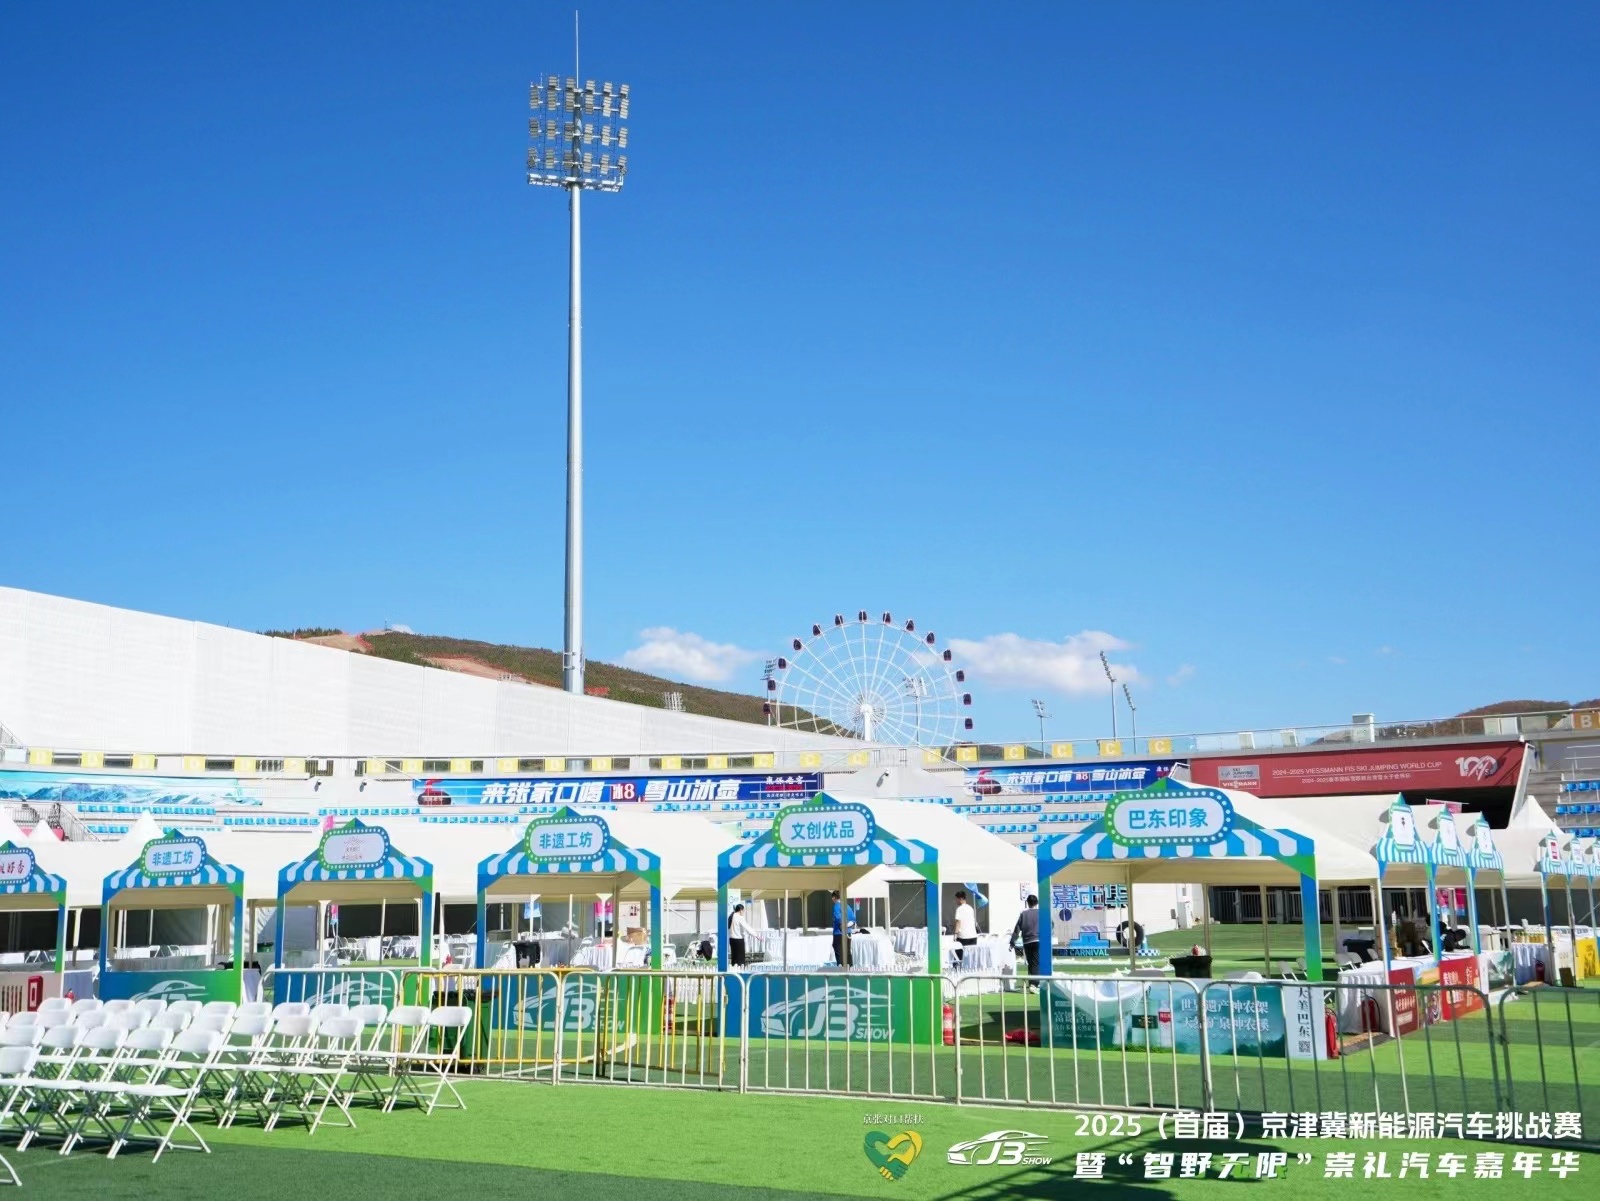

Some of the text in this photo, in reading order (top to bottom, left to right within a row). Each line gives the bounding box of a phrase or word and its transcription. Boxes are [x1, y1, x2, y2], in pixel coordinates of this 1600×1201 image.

[1581, 714, 1592, 728] B
[1009, 746, 1018, 758] C
[1057, 744, 1066, 756] C
[1106, 742, 1115, 754] C
[1155, 740, 1164, 752] C
[1305, 766, 1343, 774] VIESSMANN
[1368, 763, 1399, 771] JUMPING
[1399, 762, 1426, 770] WORLD
[1426, 761, 1443, 769] CUP
[1128, 808, 1209, 830] 巴东印象
[791, 821, 855, 840] 文创优品
[539, 832, 593, 849] 非遗工坊
[151, 849, 194, 866] 非遗工坊
[1069, 948, 1110, 957] CARNIVAL
